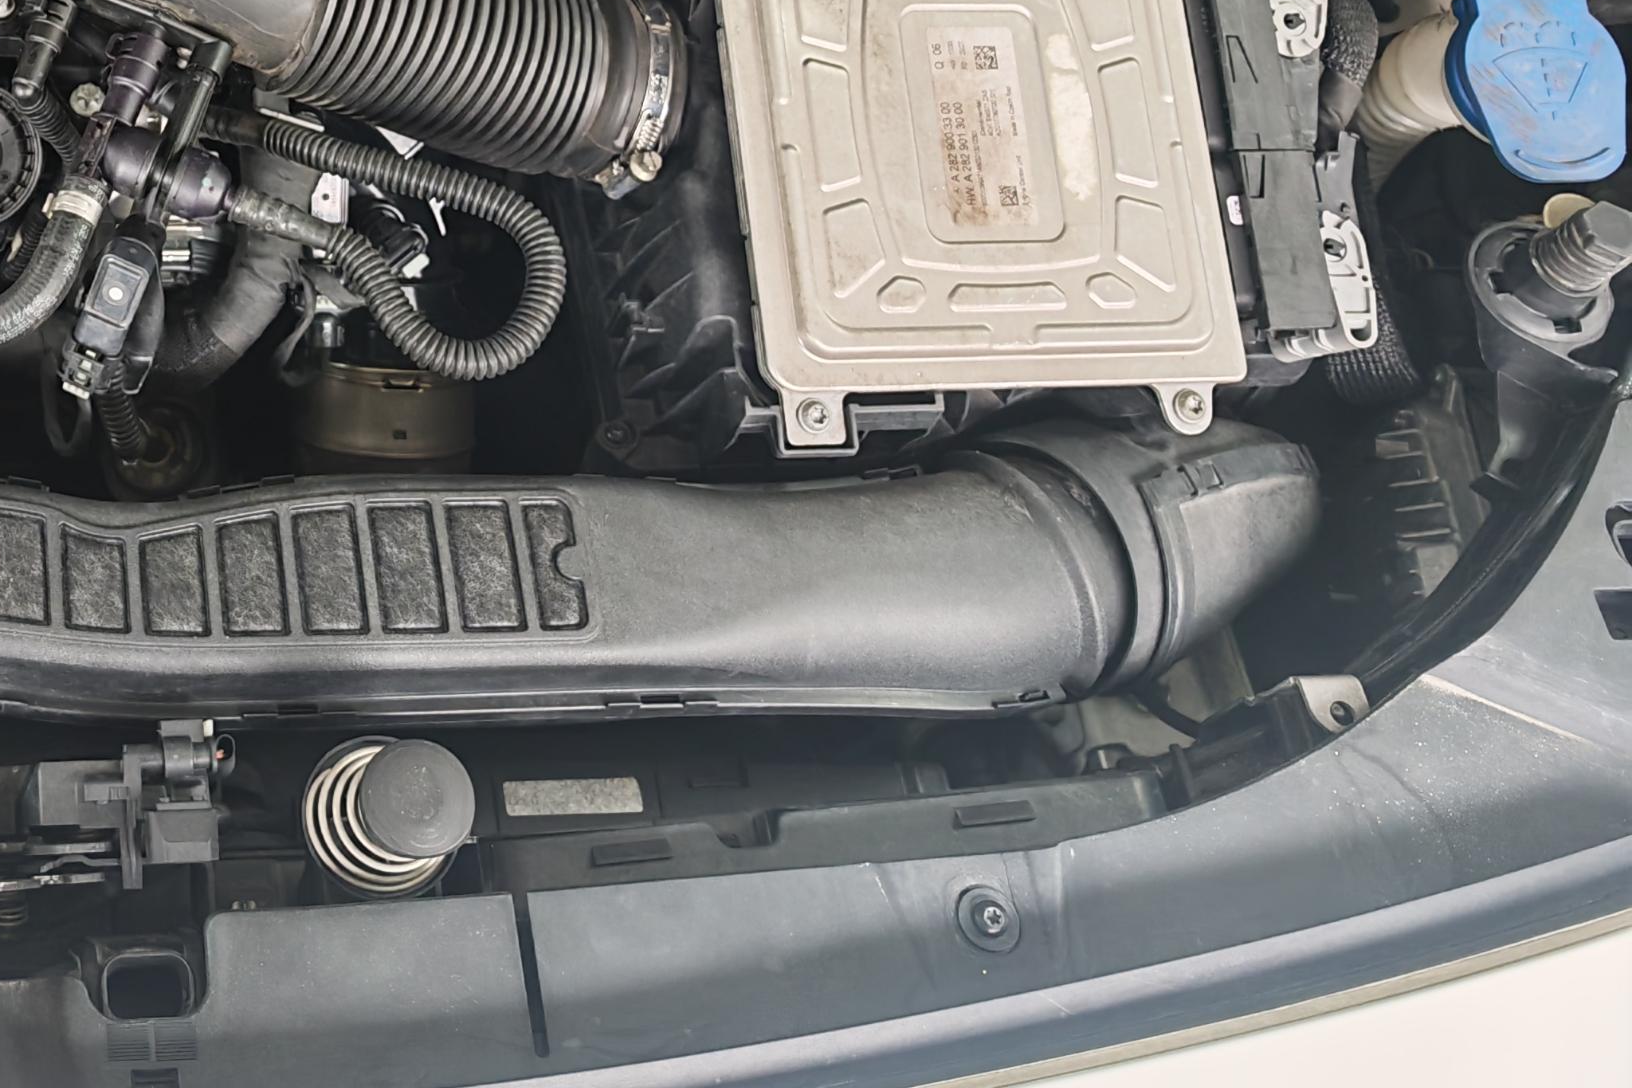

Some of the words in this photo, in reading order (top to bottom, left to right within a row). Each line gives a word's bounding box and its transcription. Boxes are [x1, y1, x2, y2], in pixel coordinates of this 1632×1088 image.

[940, 101, 951, 115] 00
[953, 101, 964, 115] 00
[942, 117, 953, 129] 33
[955, 117, 966, 129] 30
[944, 132, 956, 151] 900
[958, 133, 969, 151] 901
[948, 153, 960, 172] 282
[951, 174, 961, 183] A
[963, 174, 973, 183] A
